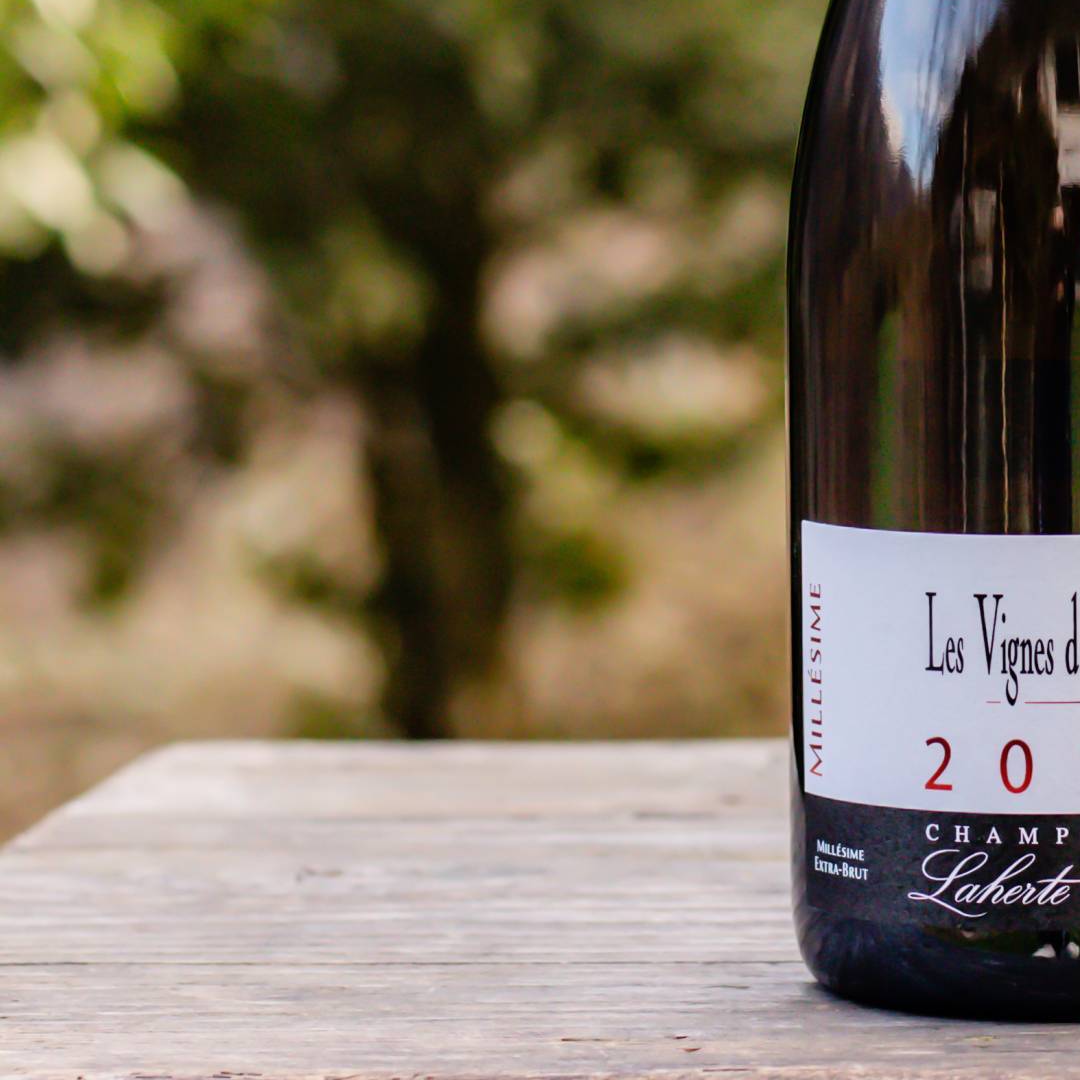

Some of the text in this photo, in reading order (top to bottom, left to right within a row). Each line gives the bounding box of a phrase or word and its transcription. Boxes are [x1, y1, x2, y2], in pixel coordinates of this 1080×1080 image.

[807, 583, 823, 777] MILLÉSIME
[924, 591, 965, 676] Les
[973, 593, 1055, 707] Vignes
[814, 855, 869, 881] EXTRA-BRUT
[816, 838, 865, 861] MILLÉSIME
